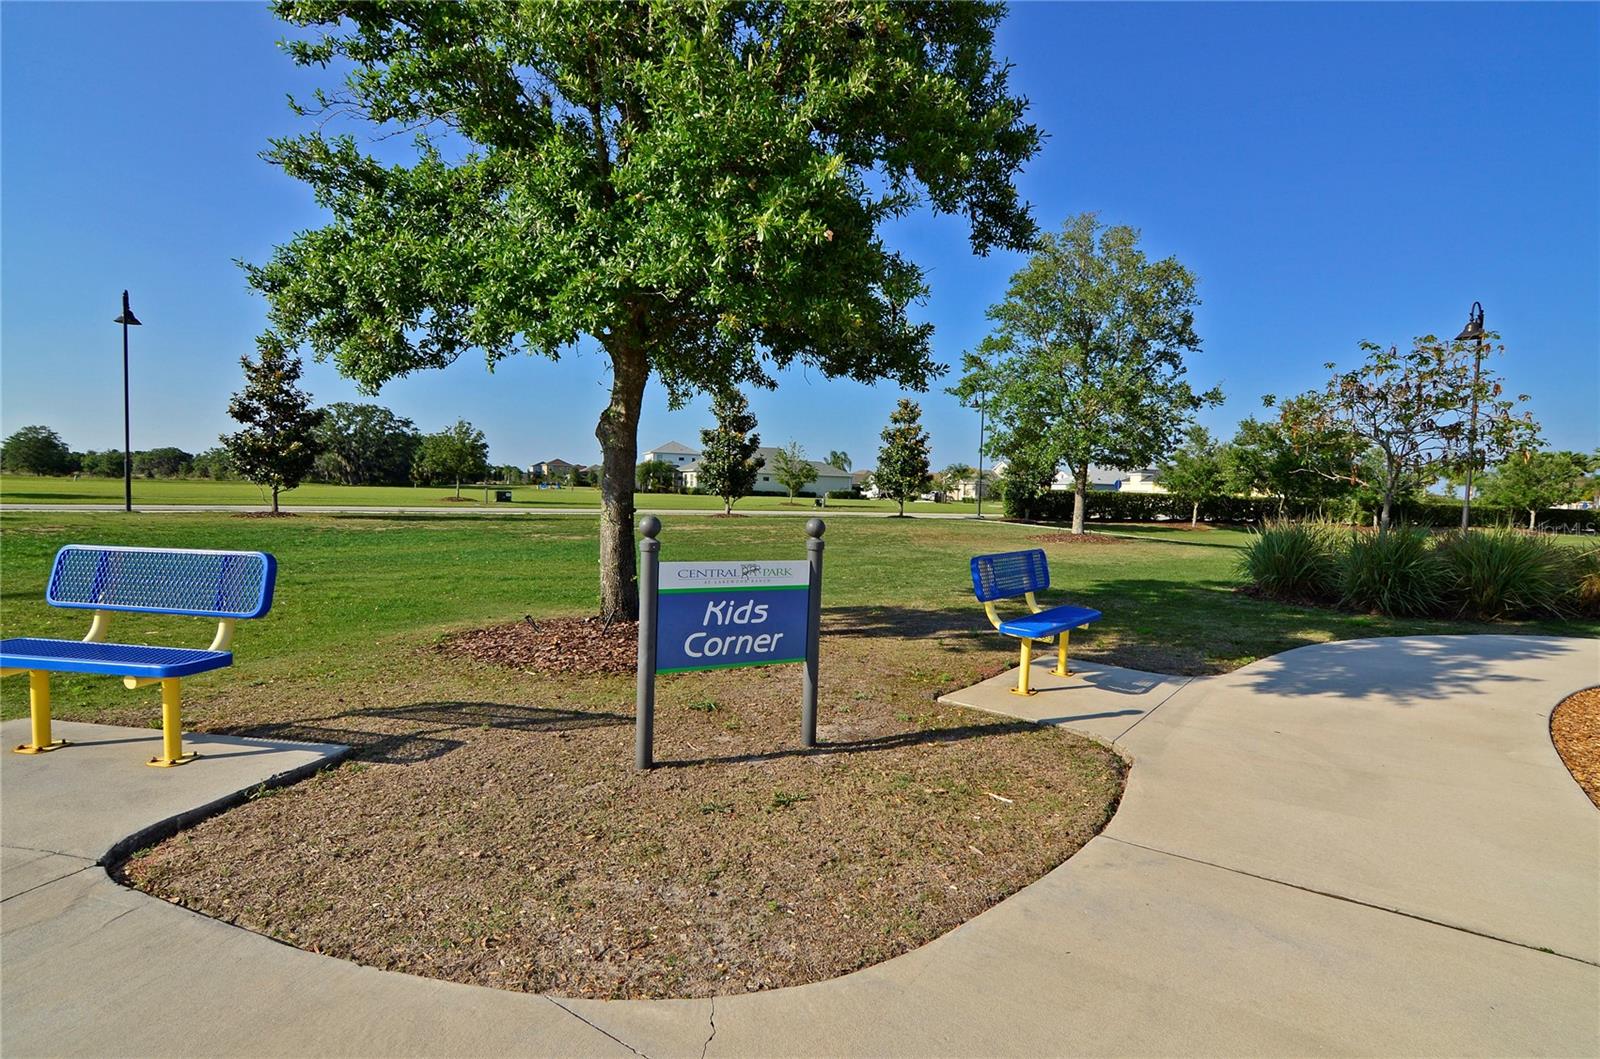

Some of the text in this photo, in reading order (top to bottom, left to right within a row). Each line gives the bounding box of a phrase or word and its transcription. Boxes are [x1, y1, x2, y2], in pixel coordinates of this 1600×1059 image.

[677, 567, 793, 579] CENTRAL PARK
[703, 599, 769, 626] Kids
[684, 632, 784, 658] Corner
